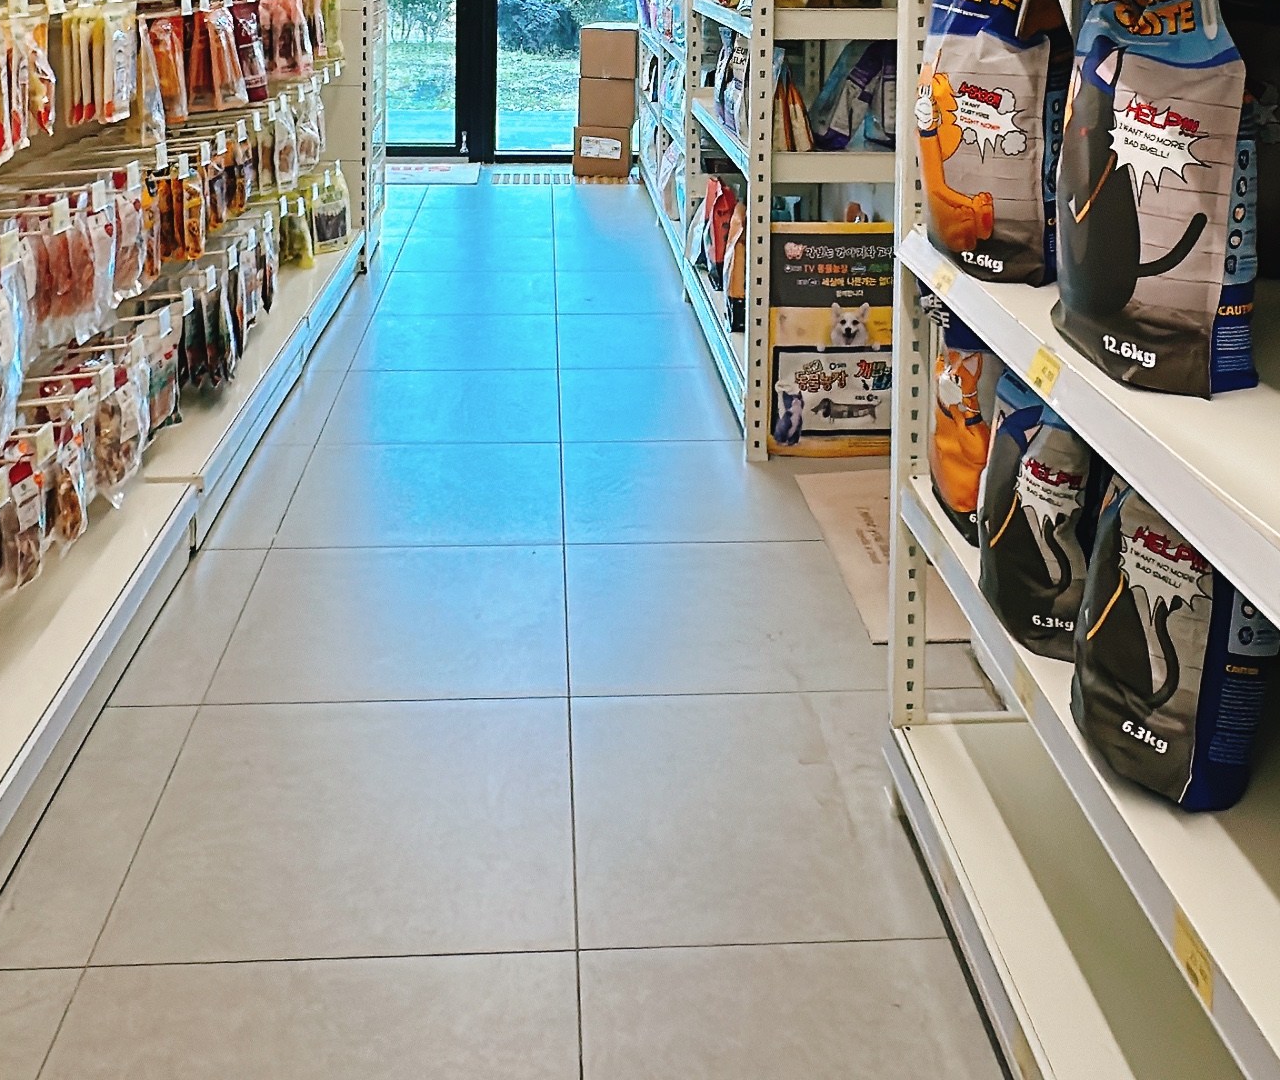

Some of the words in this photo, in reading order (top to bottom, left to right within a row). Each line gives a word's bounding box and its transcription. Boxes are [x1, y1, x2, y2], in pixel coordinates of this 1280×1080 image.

[1122, 124, 1144, 139] WANT
[1144, 132, 1157, 142] NO
[1157, 135, 1185, 151] MORE
[1123, 137, 1140, 149] BAD
[1139, 142, 1170, 159] SMELL!
[960, 250, 1005, 274] 12.6kg
[1102, 334, 1157, 370] 12.6kg
[1031, 613, 1075, 632] 6.3kg
[1122, 720, 1169, 754] 6.3kg
